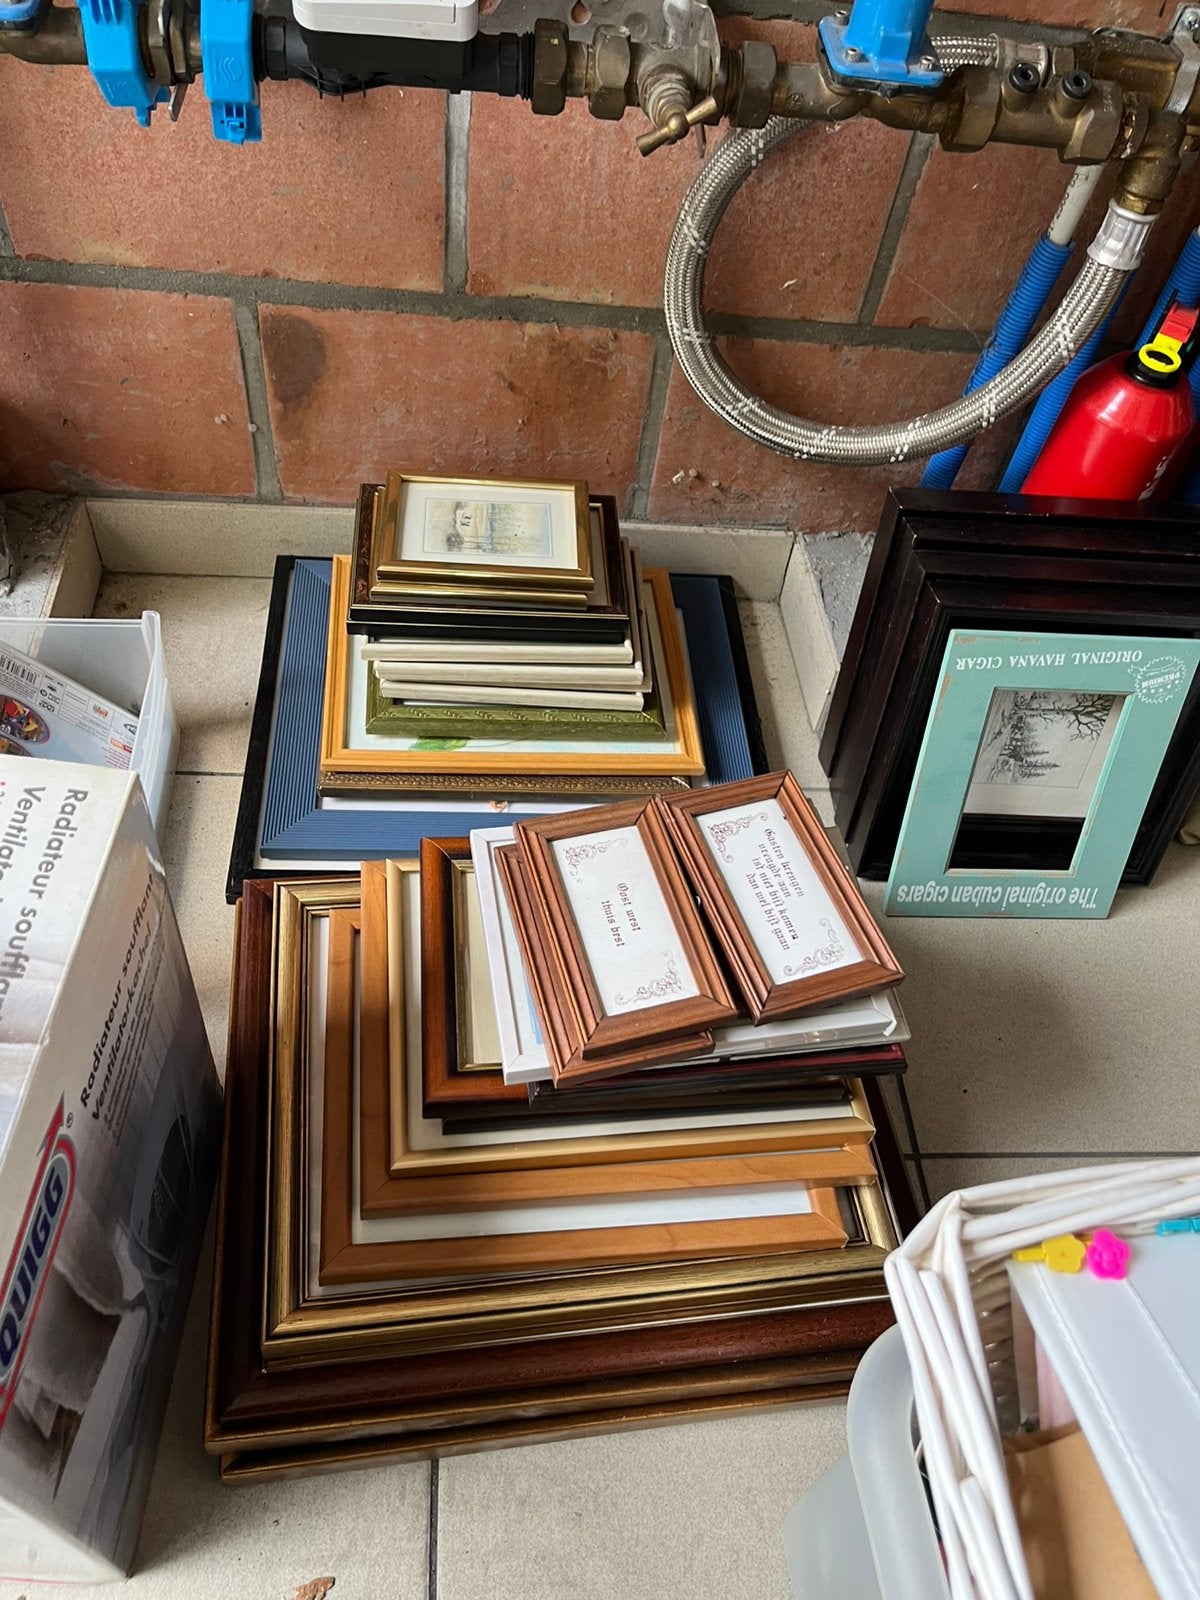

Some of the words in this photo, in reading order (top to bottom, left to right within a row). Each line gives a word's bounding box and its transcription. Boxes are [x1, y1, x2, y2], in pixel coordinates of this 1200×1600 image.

[955, 656, 1002, 671] CIGAR
[1009, 653, 1066, 668] HAVANA
[1071, 650, 1143, 665] ORIGINAL
[1141, 672, 1181, 689] PREMIUM
[29, 788, 89, 899] Radiateur
[765, 828, 784, 859] Gasten
[781, 861, 805, 897] brengen
[778, 881, 791, 898] aan
[896, 880, 949, 904] cigars
[953, 885, 1000, 907] cuban
[1001, 882, 1066, 911] original
[1069, 887, 1099, 909] The
[617, 882, 631, 906] Oost
[626, 910, 641, 931] west
[746, 873, 759, 890] dan
[755, 892, 770, 908] wel
[771, 927, 791, 951] gaan
[601, 900, 616, 924] thuis
[611, 926, 625, 947] best
[778, 908, 799, 940] komen
[80, 980, 121, 1108] Radiateur
[122, 874, 153, 976] soufflant
[91, 921, 152, 1120] Ventilatorkachel
[0, 1165, 64, 1367] QUIGG
